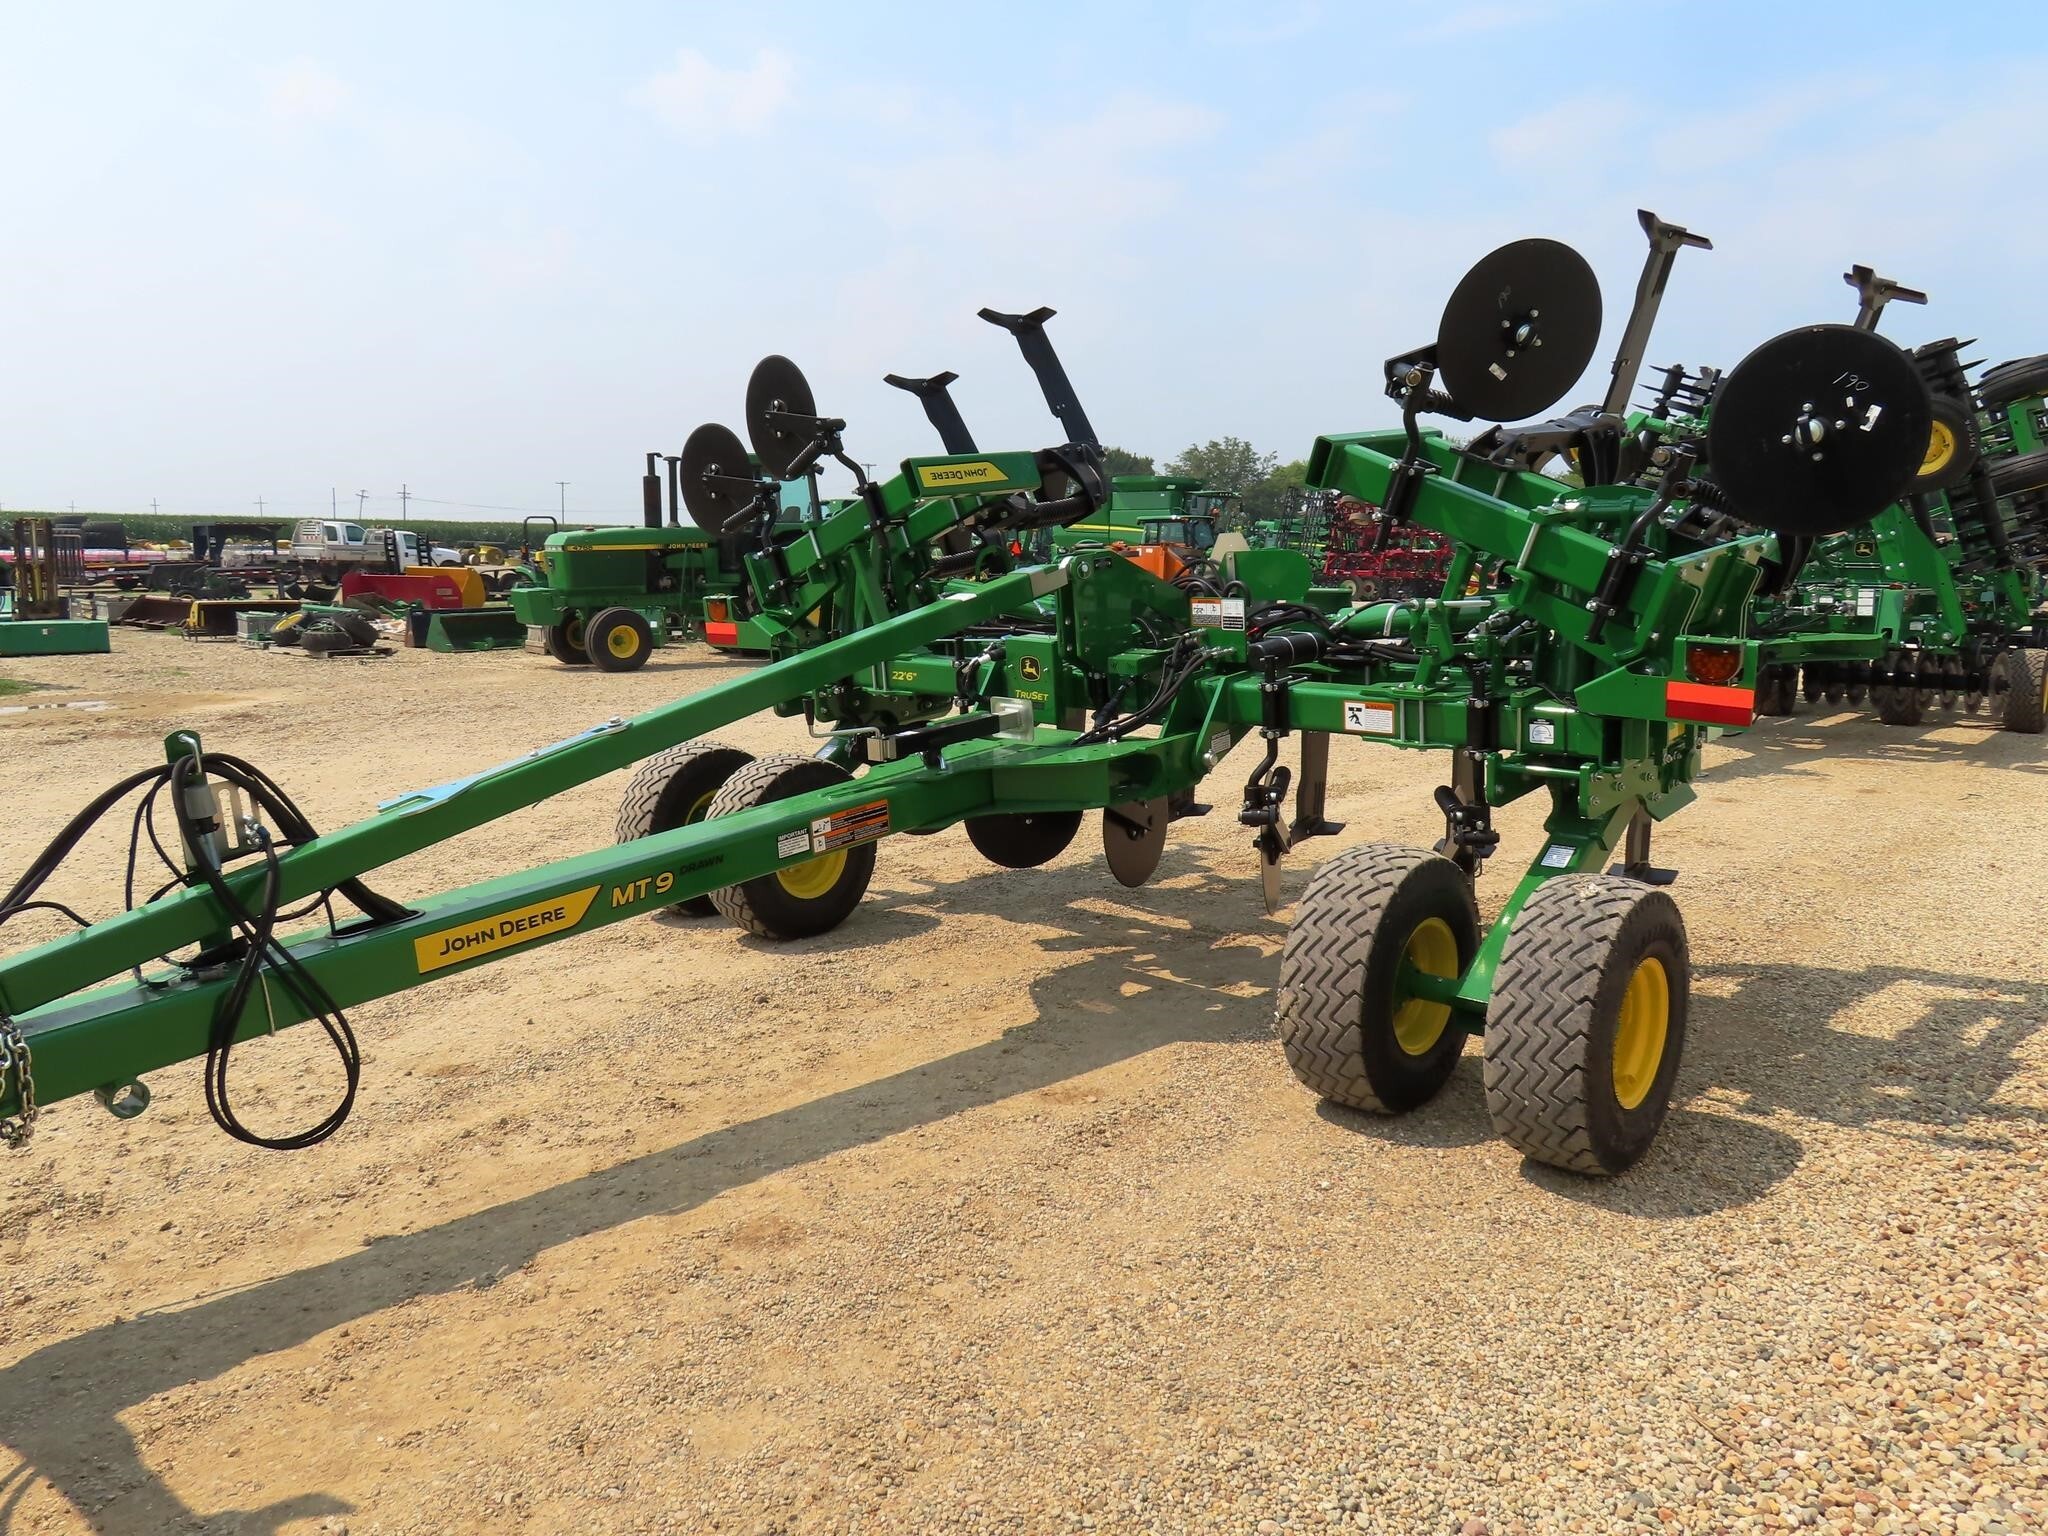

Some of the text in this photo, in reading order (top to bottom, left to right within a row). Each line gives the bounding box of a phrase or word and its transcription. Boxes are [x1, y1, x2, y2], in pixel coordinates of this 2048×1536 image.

[1832, 371, 1869, 391] 190
[930, 467, 988, 480] JOHN DEERE
[777, 828, 808, 841] IMPORTANT
[679, 854, 724, 876] DRAWN
[440, 907, 566, 956] JOHN DEERE
